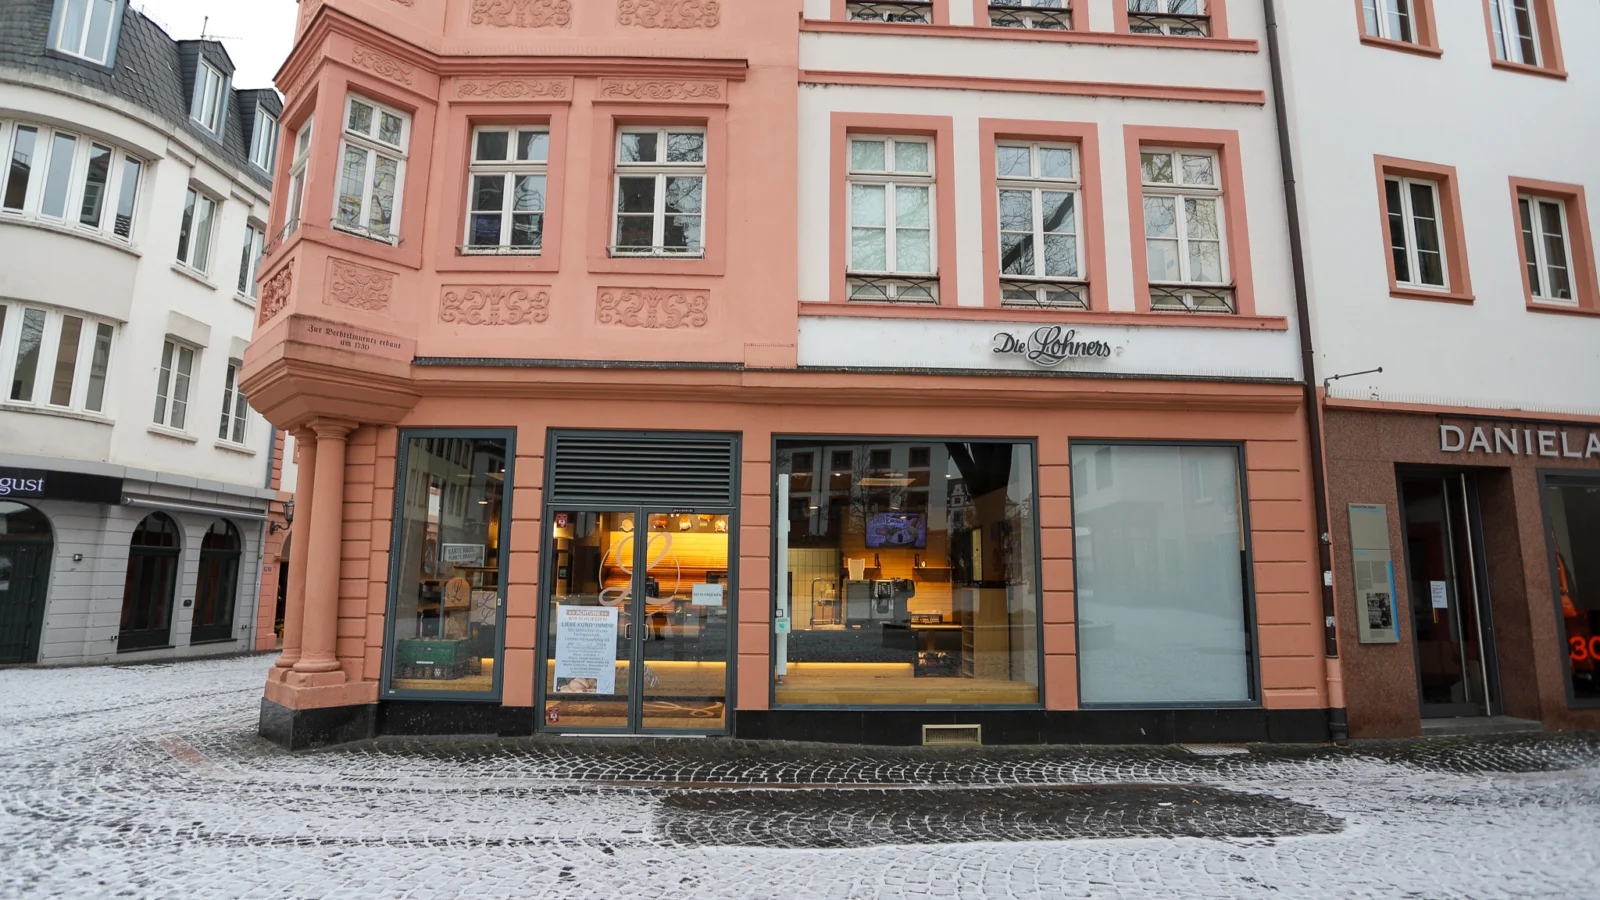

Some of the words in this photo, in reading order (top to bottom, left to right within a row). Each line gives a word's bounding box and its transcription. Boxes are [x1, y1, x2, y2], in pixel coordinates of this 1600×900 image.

[340, 339, 352, 348] um
[993, 332, 1025, 354] Die
[1028, 325, 1111, 361] Lohners
[1440, 424, 1600, 459] DANIELA
[0, 477, 45, 496] gust
